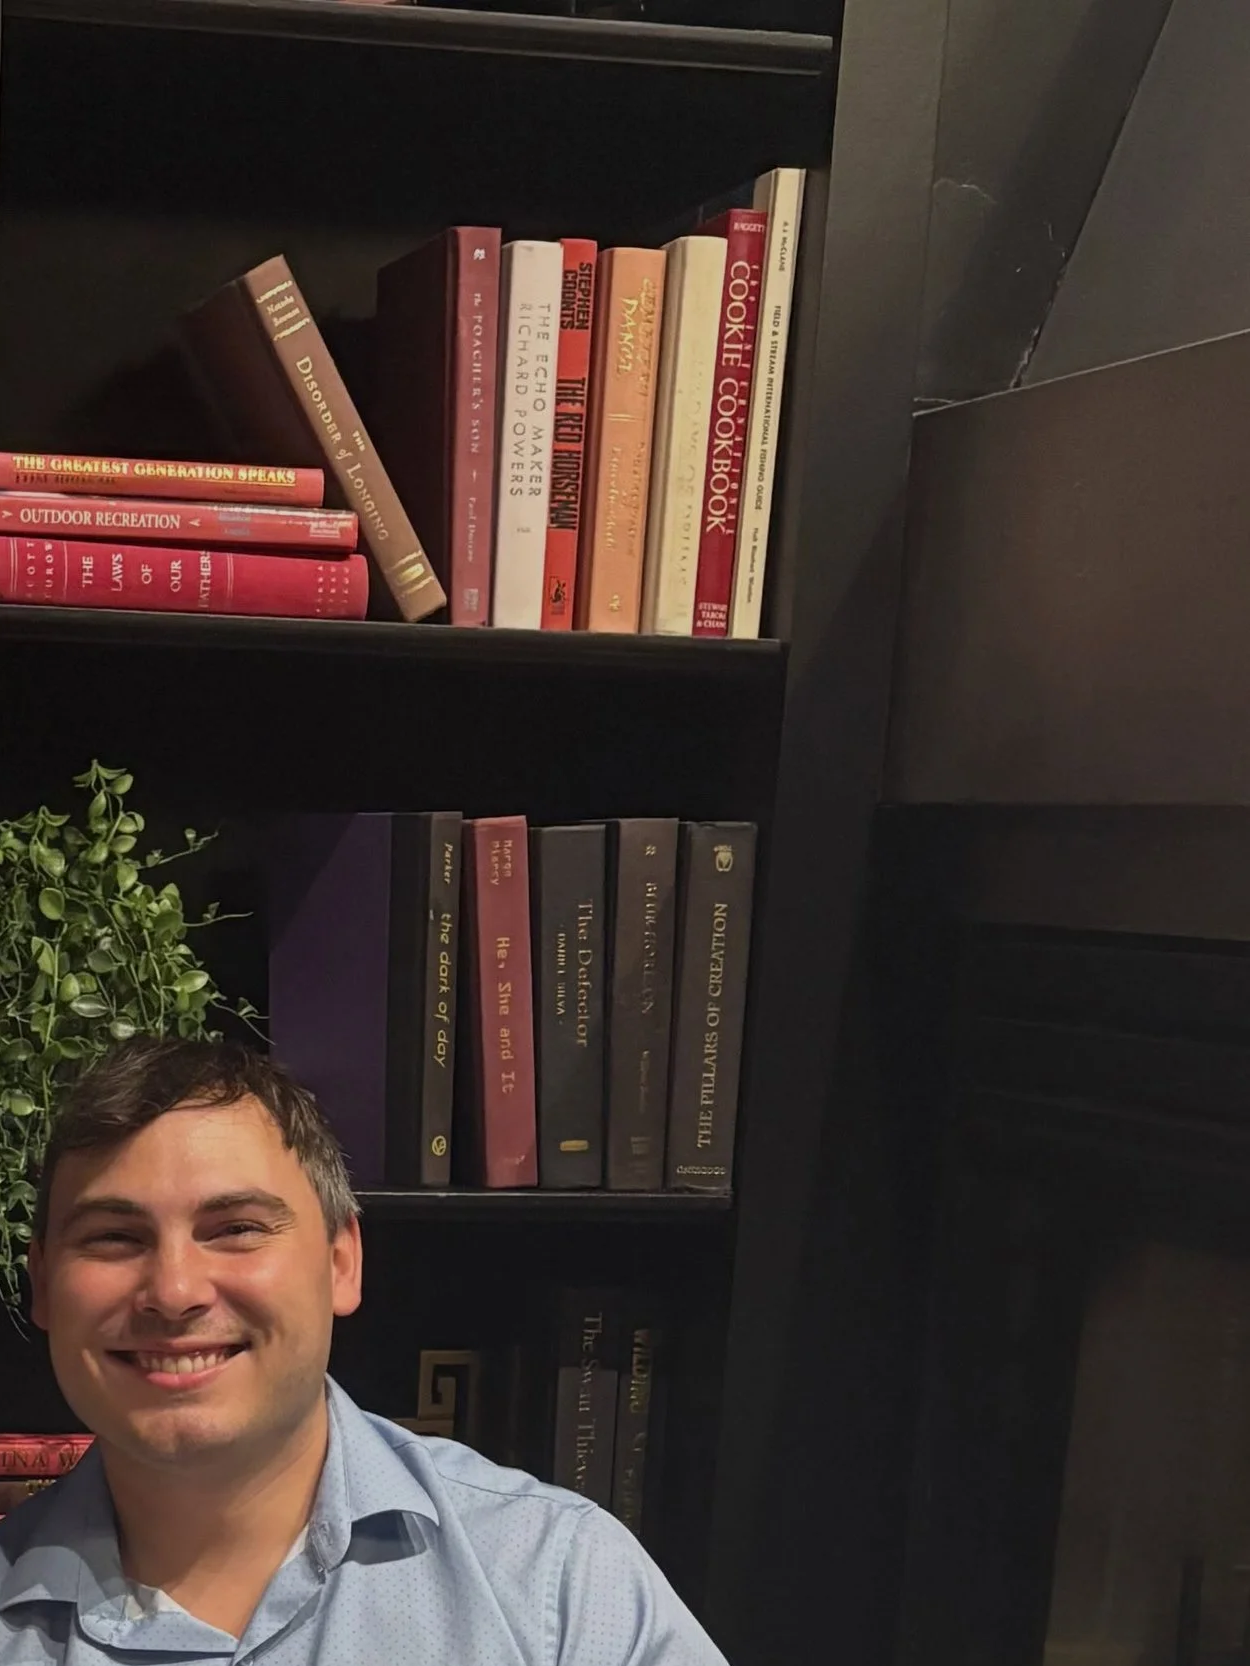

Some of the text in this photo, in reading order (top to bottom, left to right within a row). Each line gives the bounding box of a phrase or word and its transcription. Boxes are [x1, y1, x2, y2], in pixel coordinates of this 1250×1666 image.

[560, 269, 578, 331] COONTS
[575, 262, 593, 331] STEPHEN
[722, 260, 751, 368] COOKIE
[771, 305, 782, 328] FIELD
[469, 314, 484, 455] POACHER'S SON
[767, 340, 779, 375] STREAM
[509, 302, 534, 497] RICHARD POWERS
[528, 302, 552, 497] THE ECHO MAKER
[13, 455, 46, 470] THE
[50, 457, 130, 475] GREATEST
[133, 460, 235, 481] GENERATION
[237, 467, 296, 485] SPEAKS
[294, 354, 343, 447] DISORDER
[346, 462, 390, 542] LONGING
[548, 376, 587, 531] THE RED HORSEMAN
[705, 377, 739, 534] COOKBOOK
[19, 507, 181, 530] OUTDOOR RECREATION
[82, 555, 94, 589] THE
[111, 552, 124, 592] LAWS
[141, 564, 153, 585] OF
[170, 559, 182, 593] OUR
[197, 550, 211, 608] FATHERS
[433, 842, 454, 1068] Parker the dark of day
[575, 898, 594, 1049] The Defector
[498, 981, 512, 1017] She
[696, 902, 729, 1149] THE PILLARS OF CREATION
[500, 1028, 515, 1061] and
[501, 1070, 516, 1094] It
[581, 1312, 603, 1353] The
